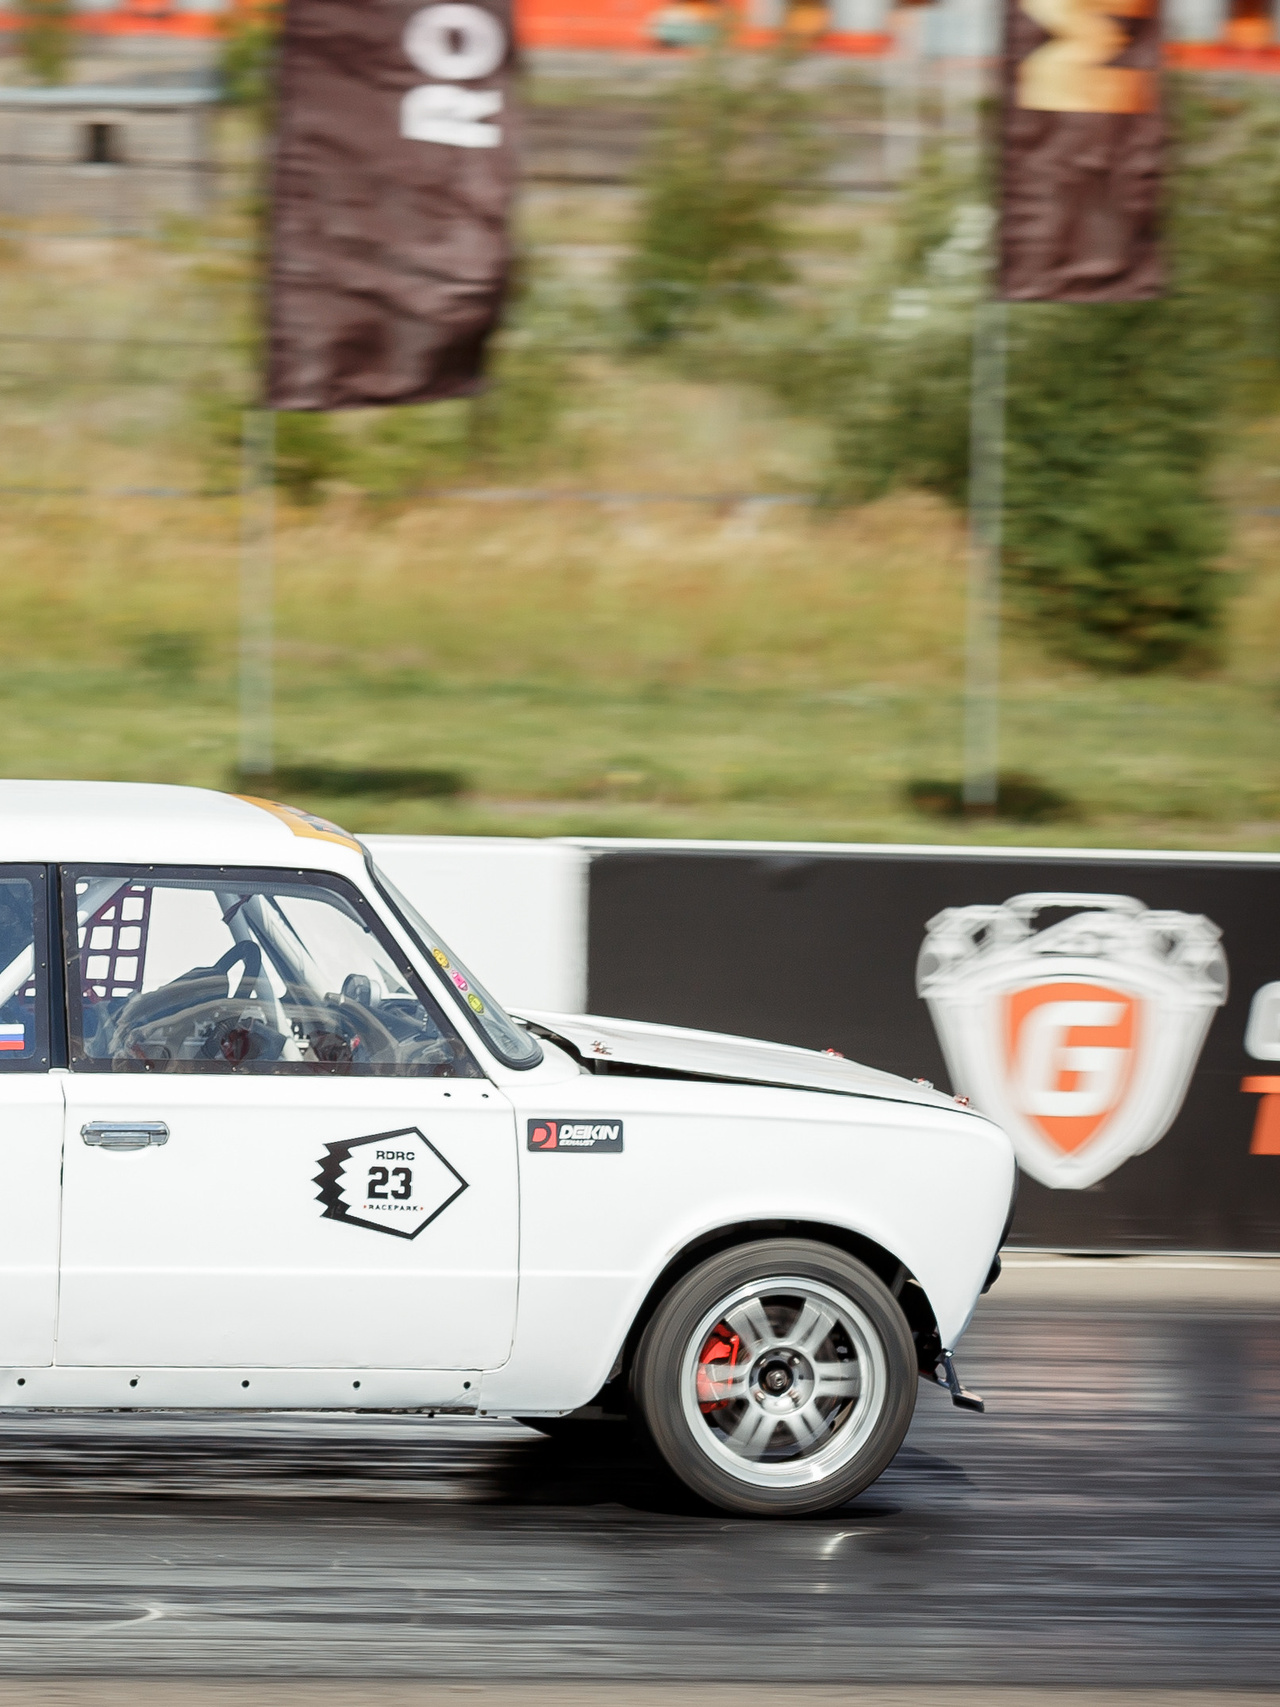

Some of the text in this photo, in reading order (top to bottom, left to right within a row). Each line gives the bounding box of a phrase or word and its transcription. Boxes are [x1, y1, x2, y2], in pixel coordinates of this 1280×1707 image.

[375, 1150, 416, 1161] RDRC
[367, 1166, 413, 1200] 23
[368, 1204, 419, 1212] RACEPARK
